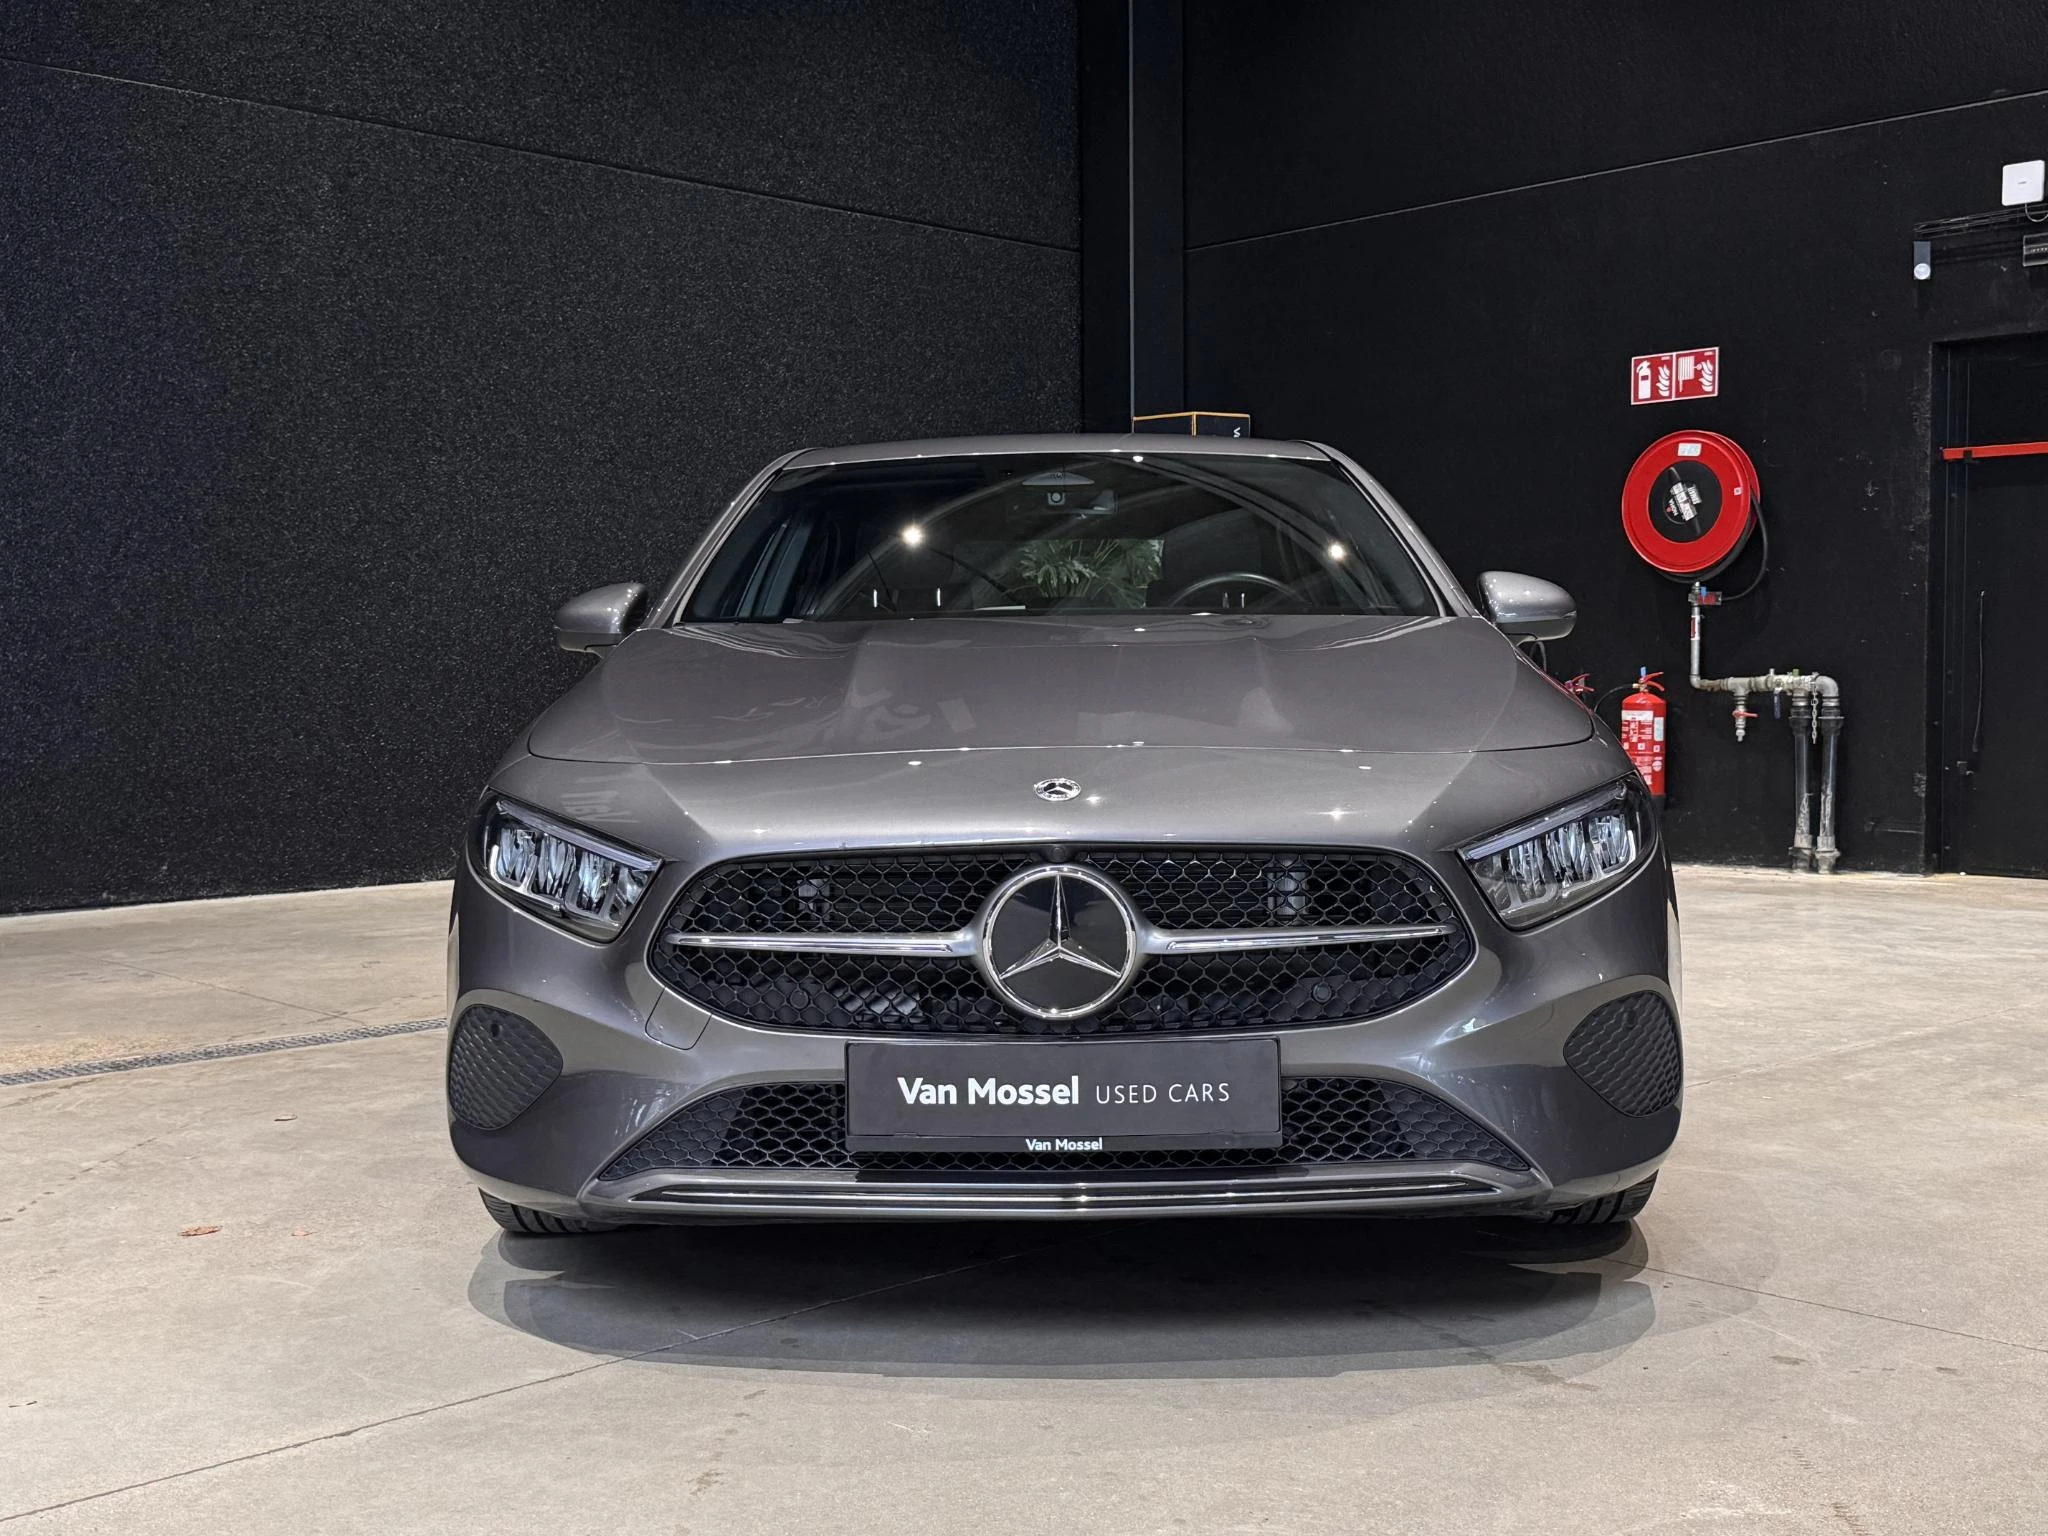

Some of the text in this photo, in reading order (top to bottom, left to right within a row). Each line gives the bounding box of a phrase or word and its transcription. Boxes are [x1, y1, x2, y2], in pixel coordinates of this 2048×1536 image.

[897, 1075, 1230, 1106] Van Mossel USED CARS
[1025, 1136, 1103, 1152] Van Mossel
